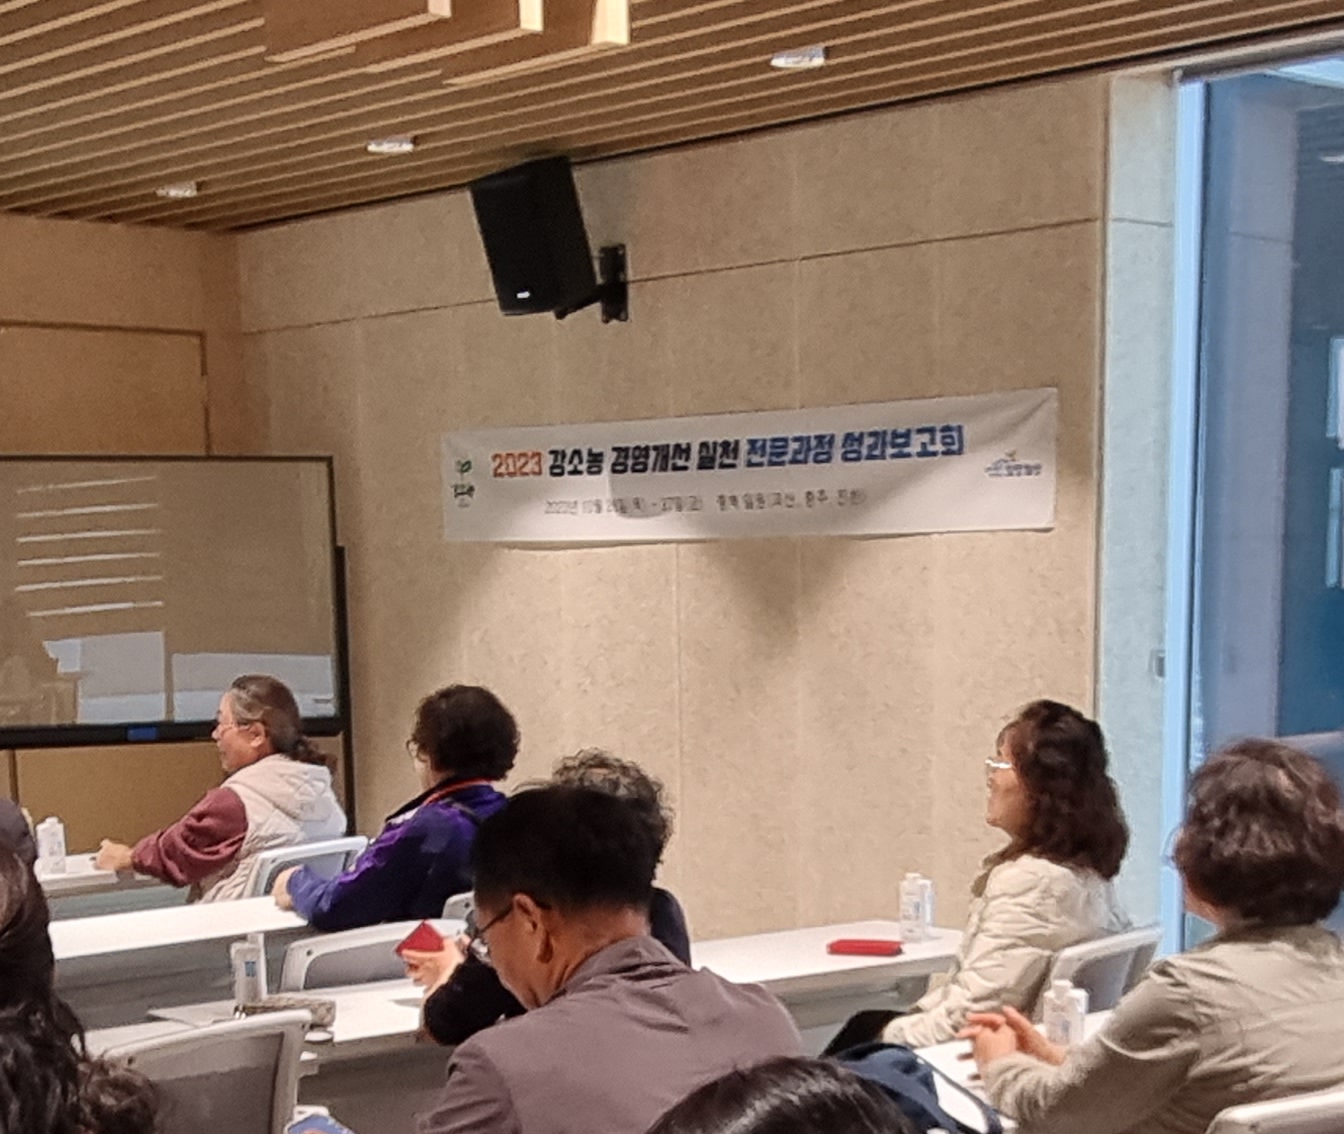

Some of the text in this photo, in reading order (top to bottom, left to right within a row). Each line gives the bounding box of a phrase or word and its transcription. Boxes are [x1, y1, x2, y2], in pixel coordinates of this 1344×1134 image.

[492, 424, 964, 478] 2023 강소농 경영개선 실천 전문과정 성과보고회
